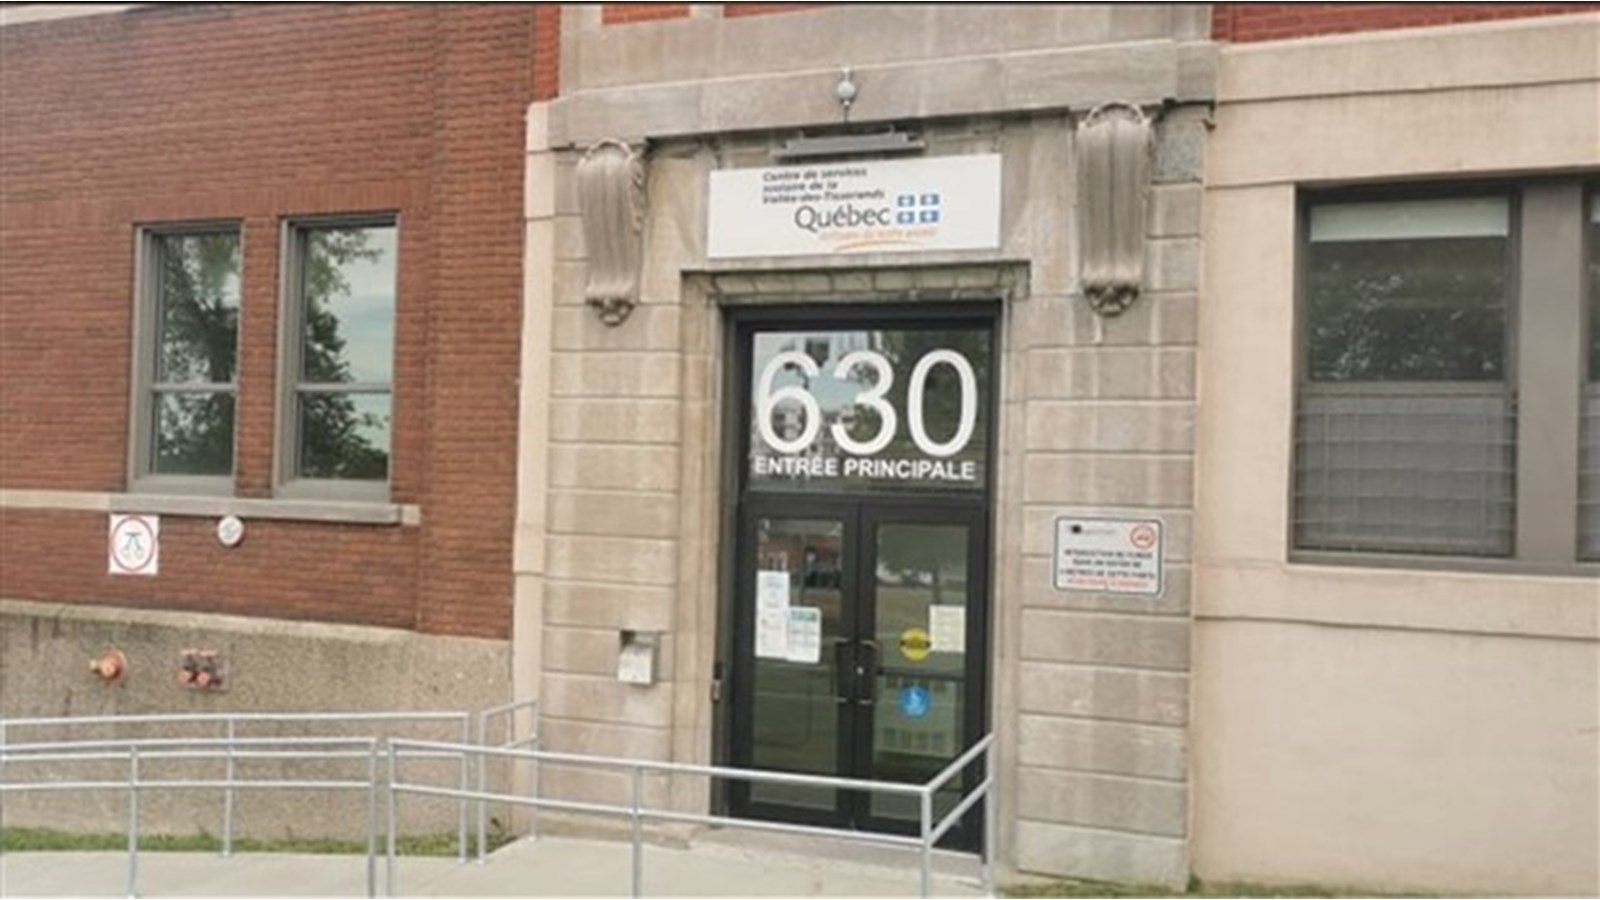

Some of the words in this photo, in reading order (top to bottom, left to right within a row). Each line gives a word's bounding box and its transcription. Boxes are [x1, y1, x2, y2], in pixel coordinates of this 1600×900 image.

[763, 171, 800, 182] Centre
[804, 169, 818, 180] de
[821, 168, 868, 179] services
[763, 183, 805, 194] scolaire
[809, 182, 823, 192] de
[826, 181, 838, 191] la
[794, 204, 891, 232] Québec
[756, 348, 978, 457] 630
[754, 455, 839, 477] ENTRÉE
[844, 458, 977, 481] PRINCIPALE
